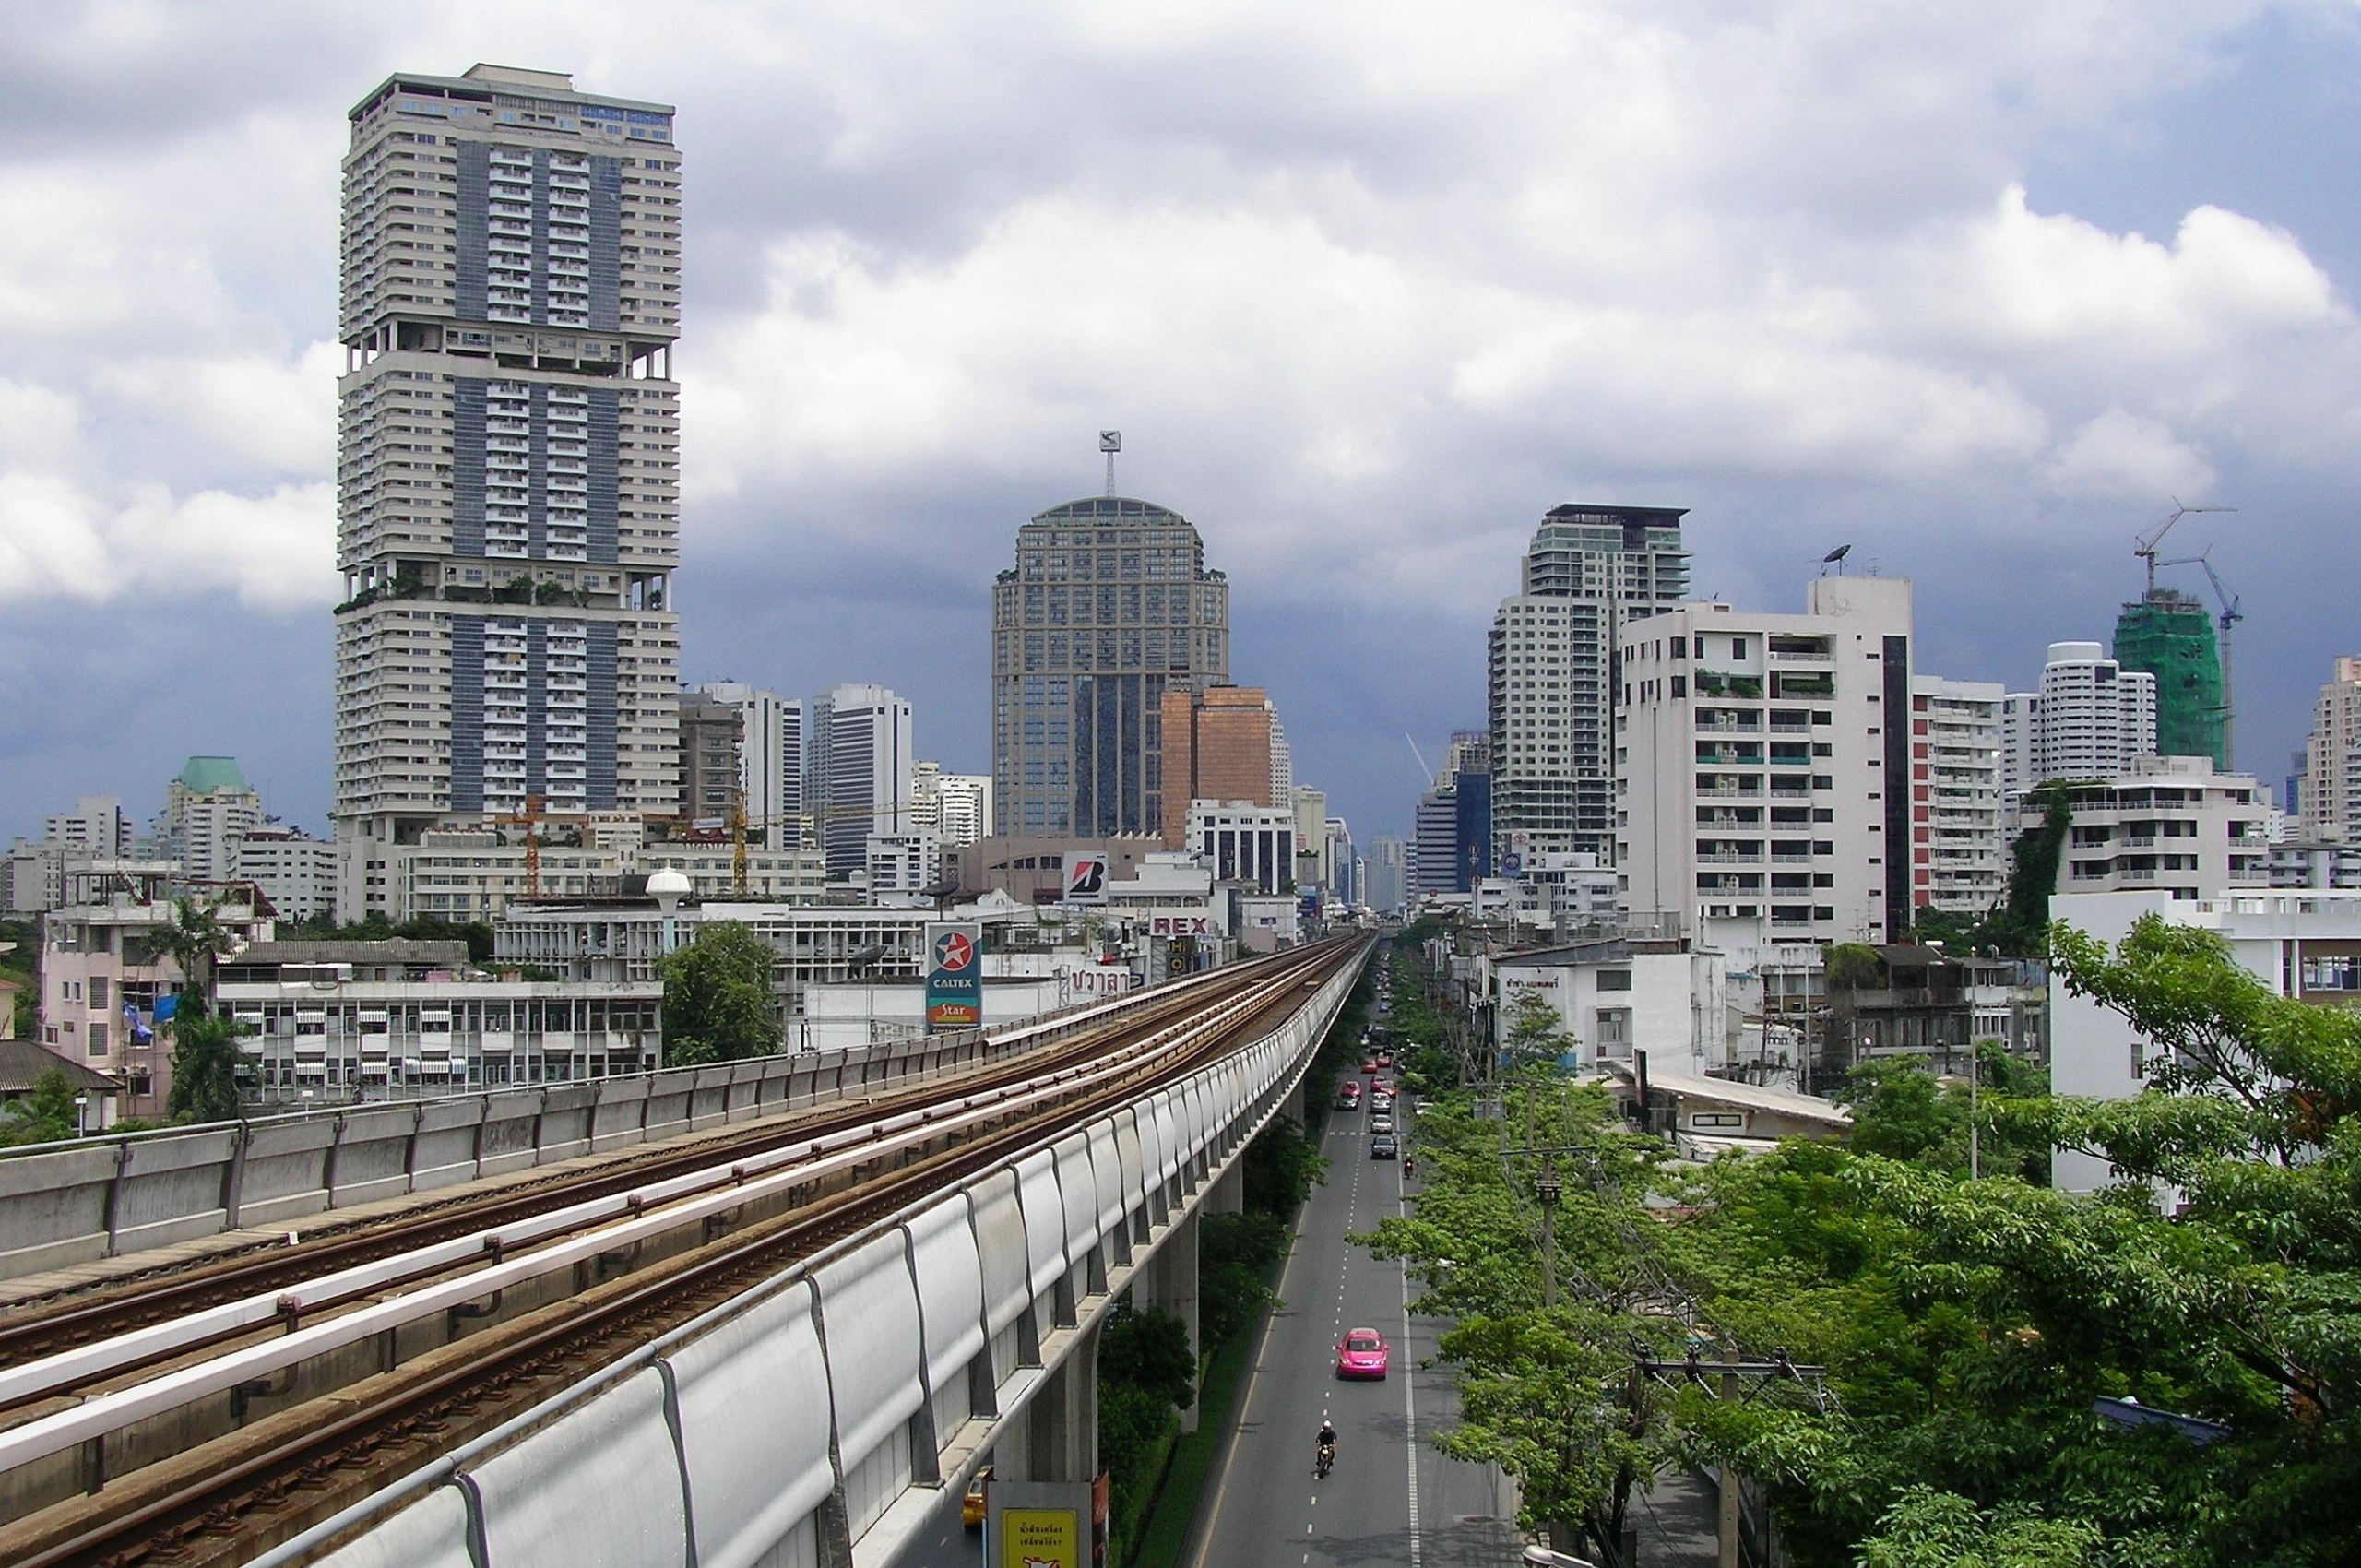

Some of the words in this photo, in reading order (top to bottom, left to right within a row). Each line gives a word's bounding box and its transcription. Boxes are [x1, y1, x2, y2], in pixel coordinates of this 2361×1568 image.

[1154, 918, 1206, 933] REX
[933, 979, 972, 988] CALTEX
[942, 1004, 965, 1016] Star
